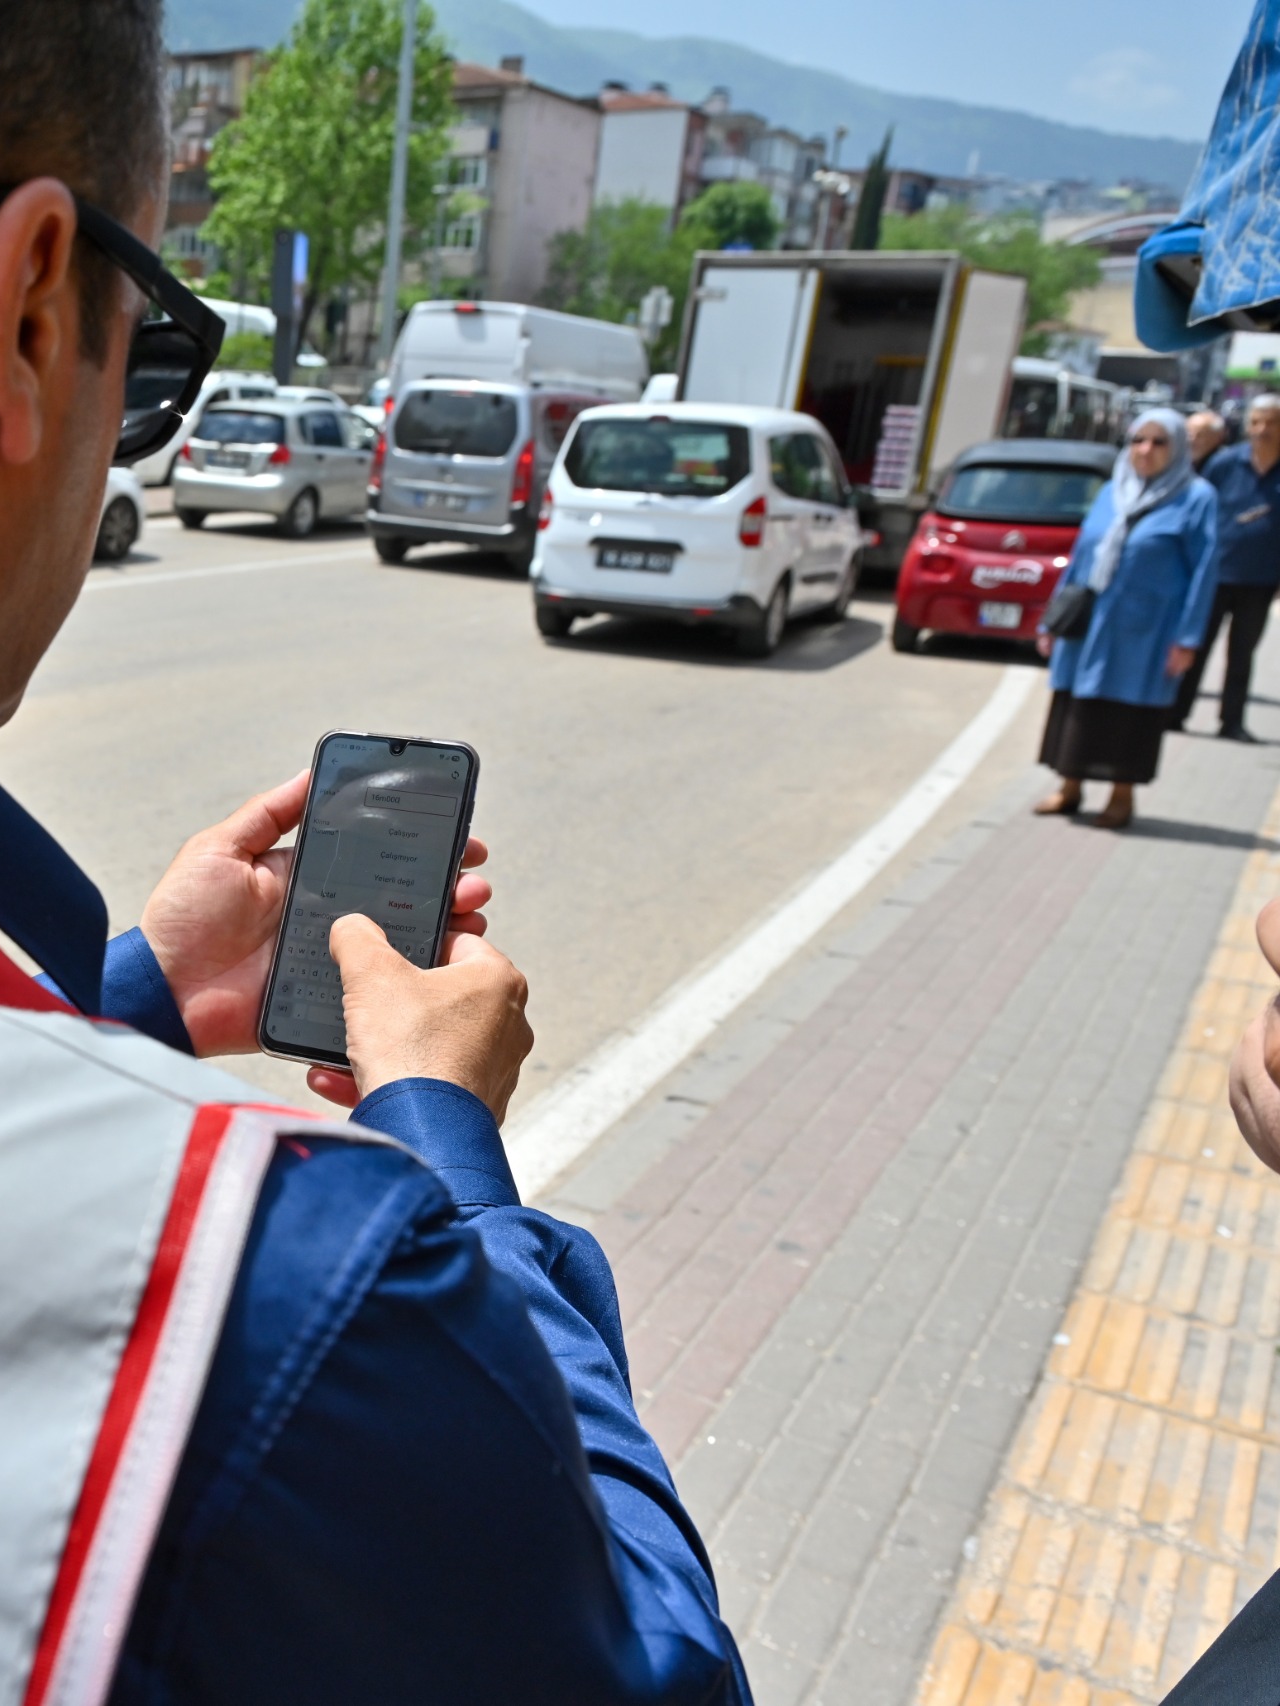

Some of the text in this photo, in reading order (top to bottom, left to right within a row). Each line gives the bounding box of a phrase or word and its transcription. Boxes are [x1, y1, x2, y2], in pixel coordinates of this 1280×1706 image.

[388, 827, 420, 839] Çalışıyor
[379, 851, 419, 863] Çalışmıyor
[388, 899, 414, 912] Kaydet
